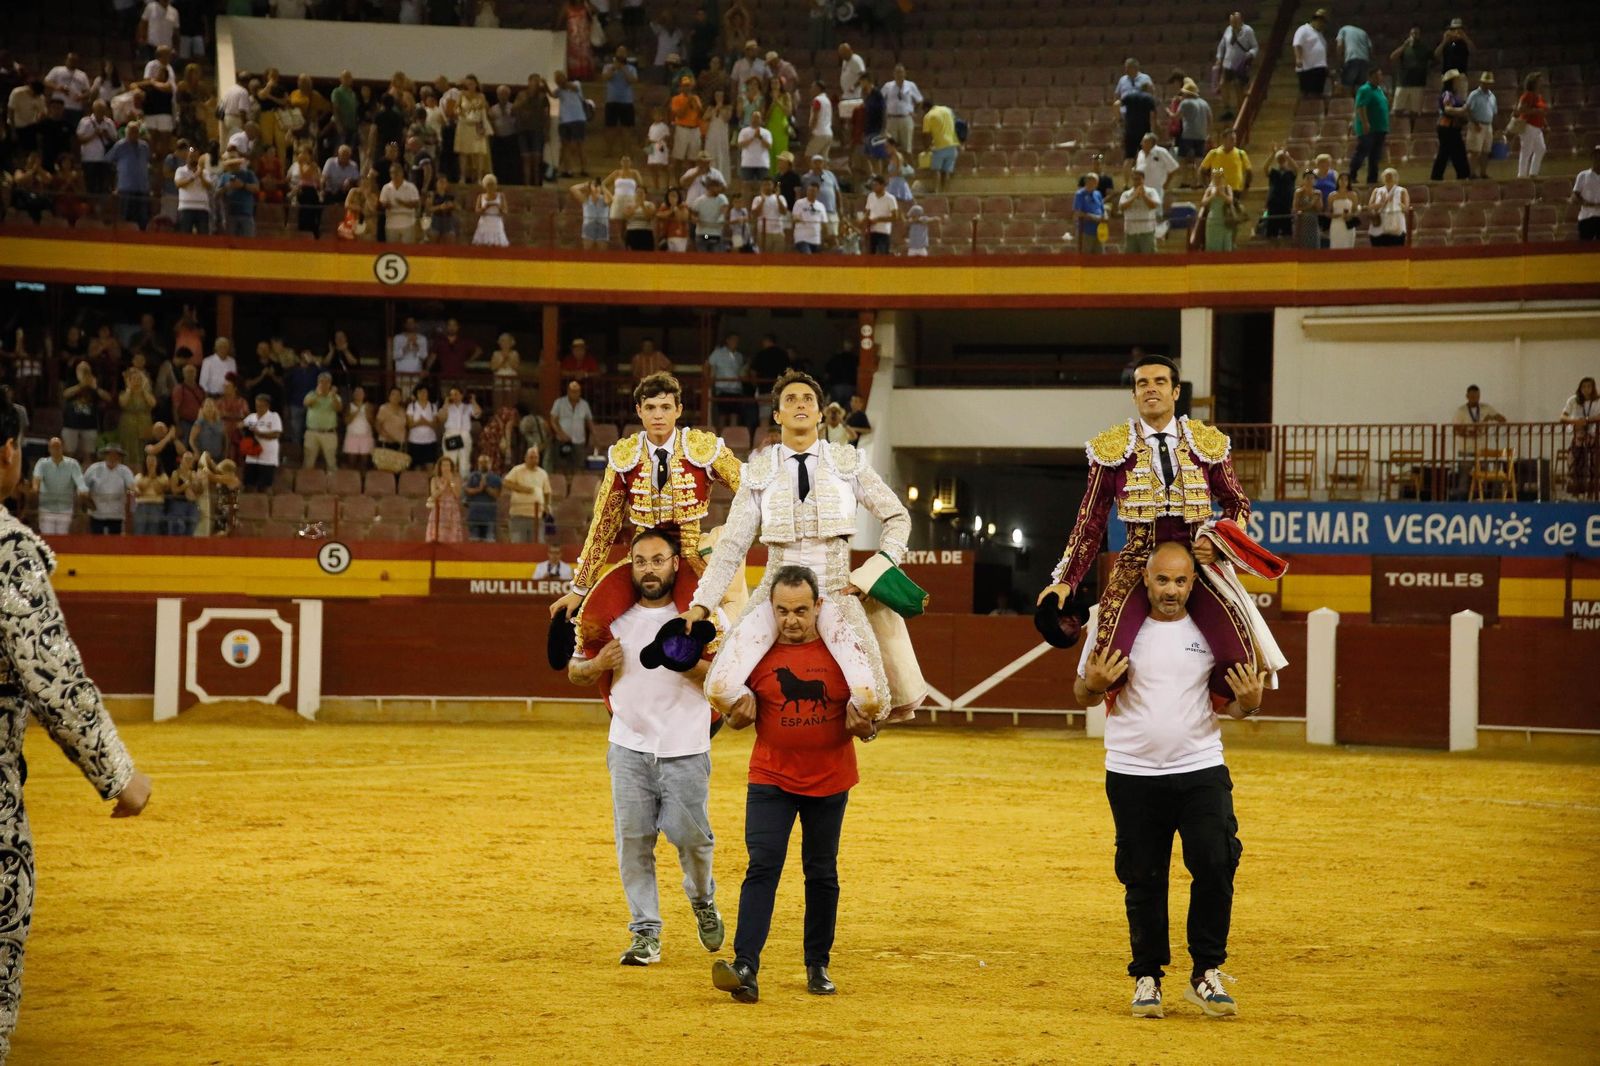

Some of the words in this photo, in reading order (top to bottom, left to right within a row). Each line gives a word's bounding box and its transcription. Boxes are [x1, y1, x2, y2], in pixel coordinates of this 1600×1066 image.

[384, 258, 399, 280] 5
[1384, 512, 1531, 548] VERANO
[1543, 521, 1577, 545] de
[328, 547, 341, 568] 5
[941, 550, 963, 564] DE
[1384, 572, 1484, 587] TORILES
[781, 714, 828, 727] ESPAÑA
